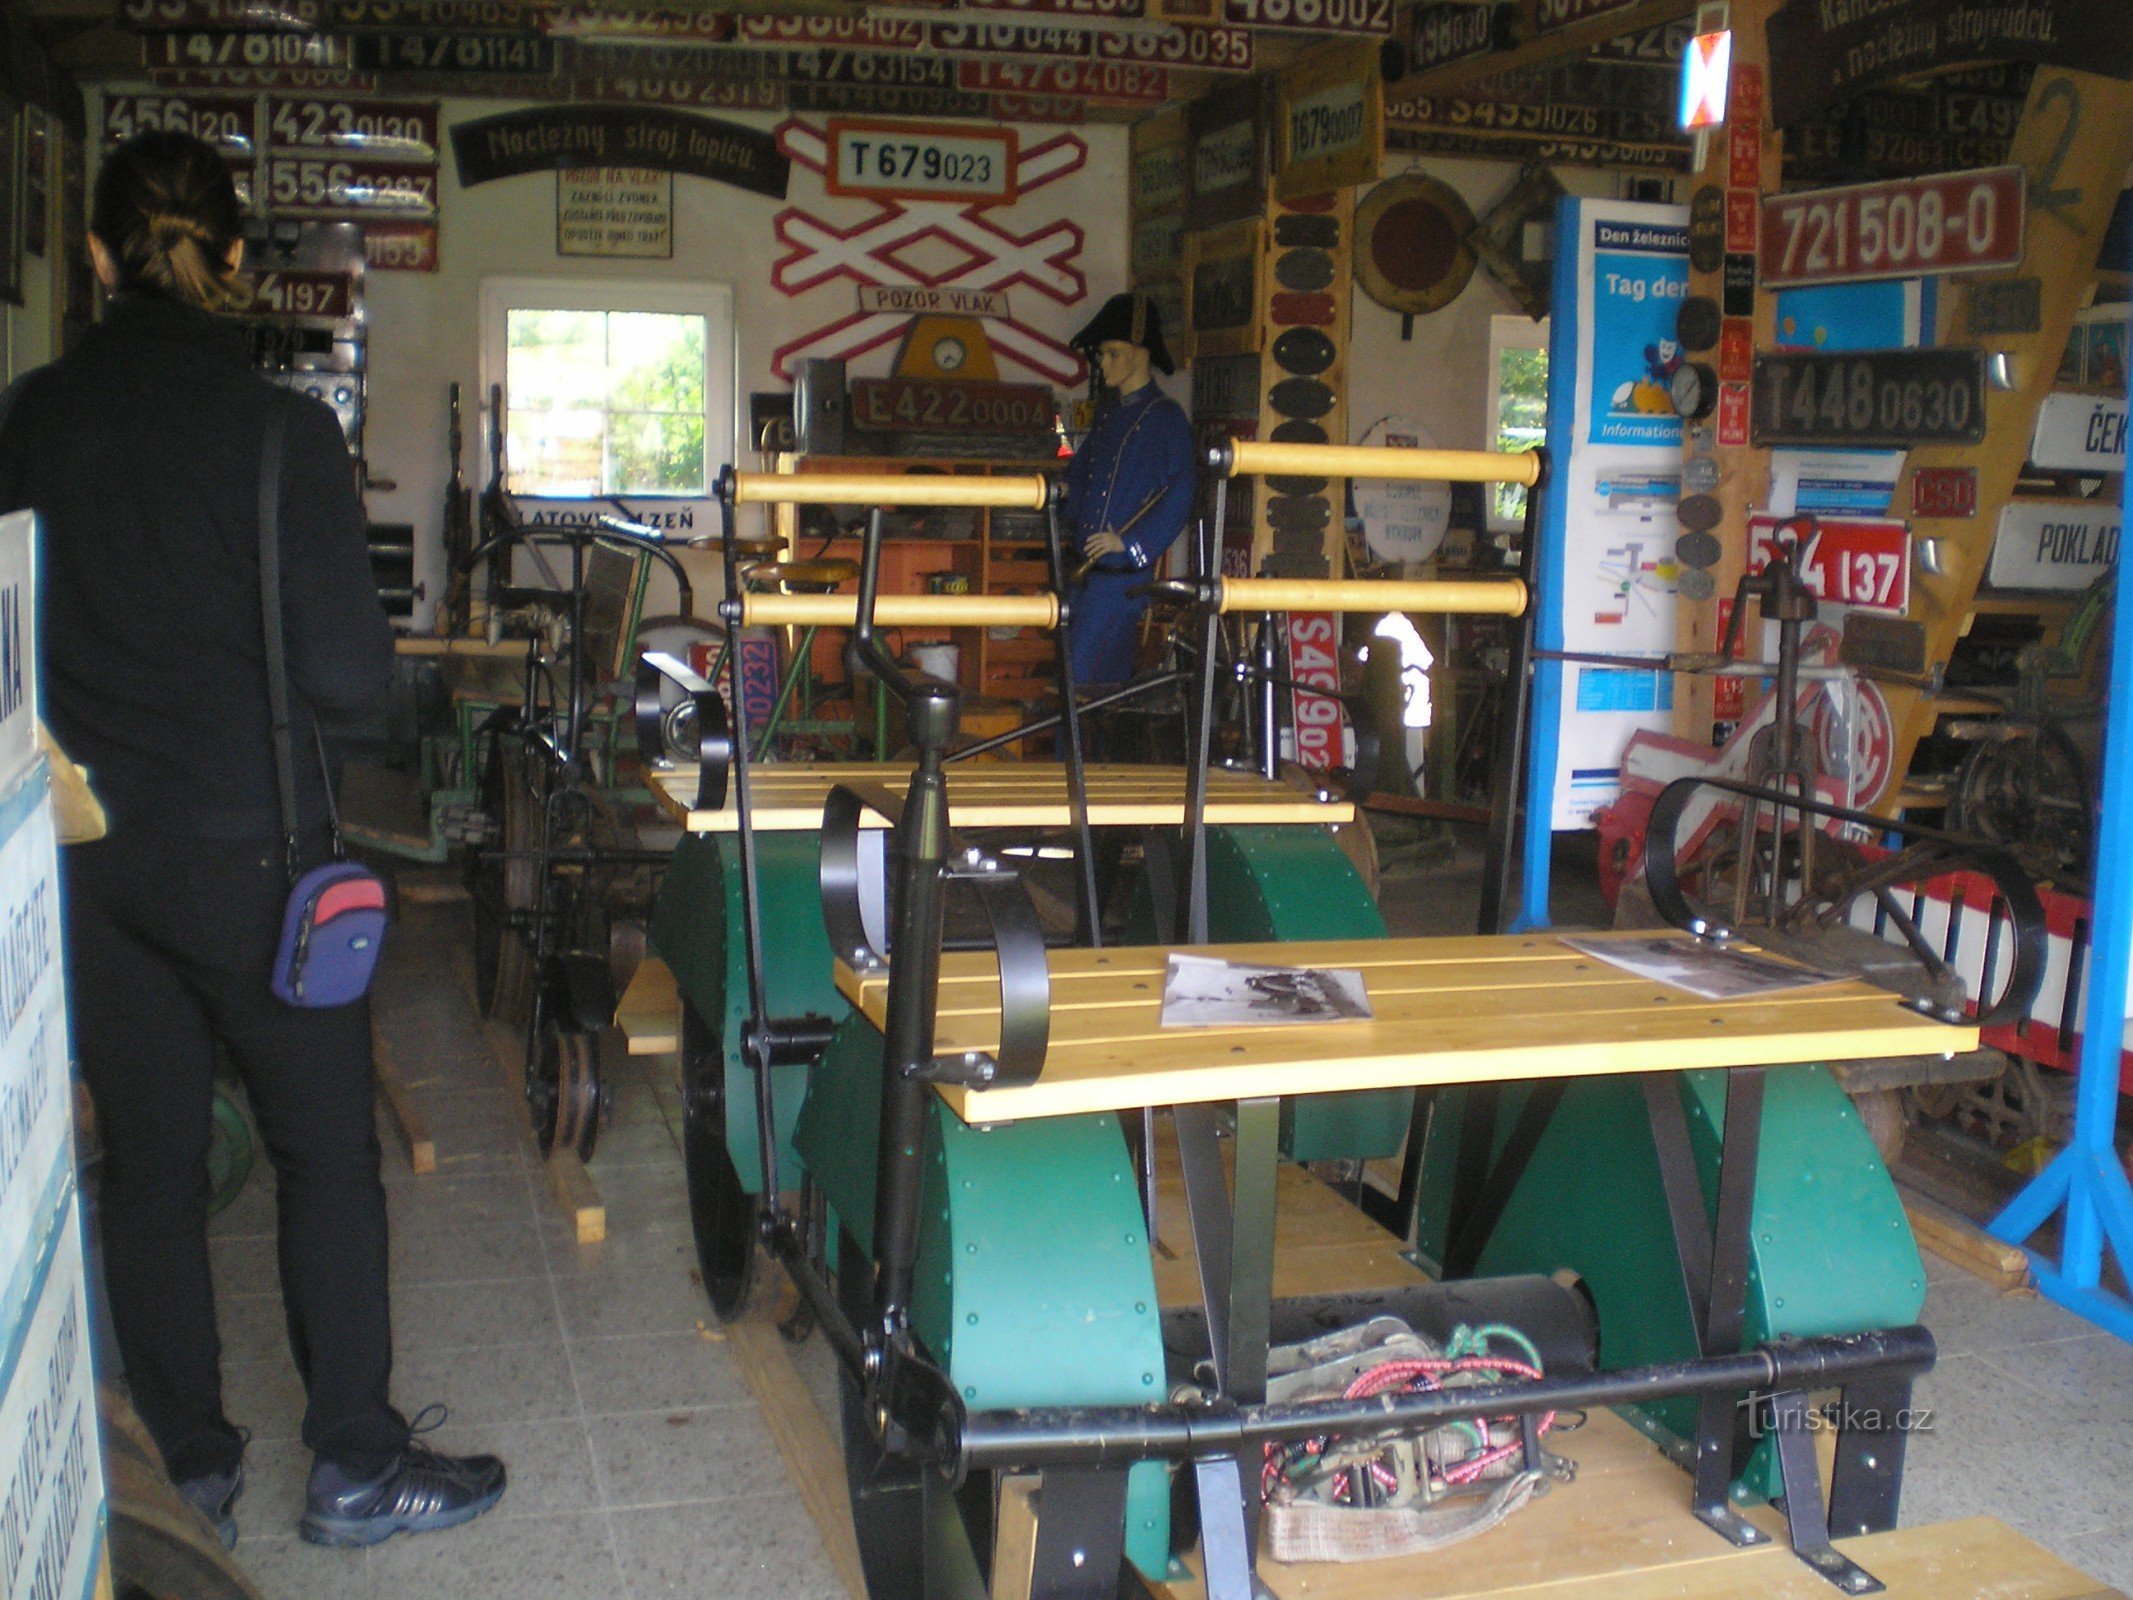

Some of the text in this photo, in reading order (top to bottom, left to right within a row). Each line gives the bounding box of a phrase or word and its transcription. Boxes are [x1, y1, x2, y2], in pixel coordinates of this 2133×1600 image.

[1599, 227, 1689, 245] Den železnic
[1781, 184, 1996, 273] 721508-0
[877, 287, 995, 312] POZOR VLAK
[1605, 273, 1647, 302] Tag
[1766, 363, 1971, 430] T4480630
